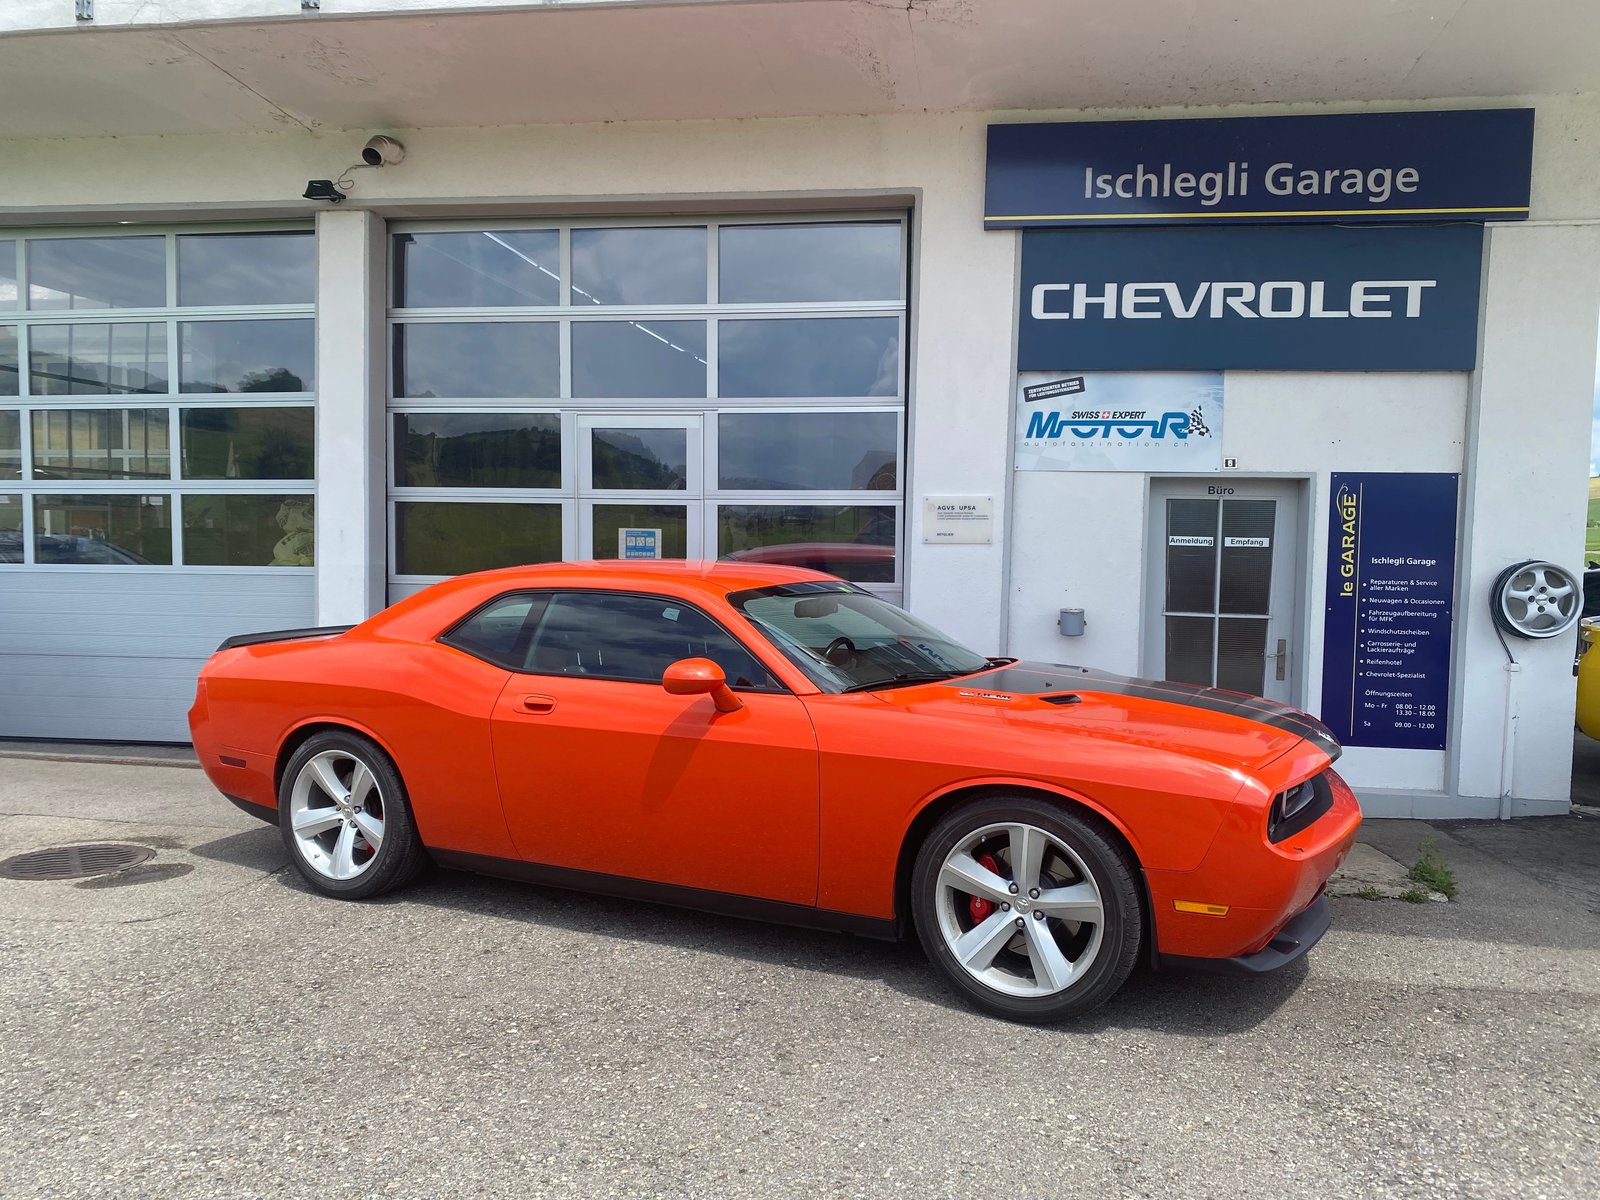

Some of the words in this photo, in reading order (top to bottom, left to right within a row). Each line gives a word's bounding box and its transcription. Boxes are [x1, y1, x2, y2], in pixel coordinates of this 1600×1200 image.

[1084, 161, 1249, 206] Ischlegli
[1264, 162, 1420, 203] Garage
[1031, 279, 1437, 320] CHEVROLET
[1071, 411, 1101, 420] SWISS
[1112, 411, 1147, 420] EXPERT
[1207, 486, 1235, 495] Büro
[1341, 493, 1357, 578] GARAGE
[1169, 537, 1213, 546] Anmeldung
[1230, 538, 1264, 547] Empfang
[1371, 557, 1404, 566] Ischlegli
[1406, 557, 1437, 567] Garage
[1340, 581, 1354, 597] le
[1369, 597, 1403, 605] Neuwagen
[1368, 610, 1437, 618] Fahrzeugaufbereitung
[1367, 628, 1430, 636] Windschutzscheiben
[1366, 671, 1426, 679] Chevrolet-Spezialist
[1365, 689, 1412, 698] Öffnungszeiten
